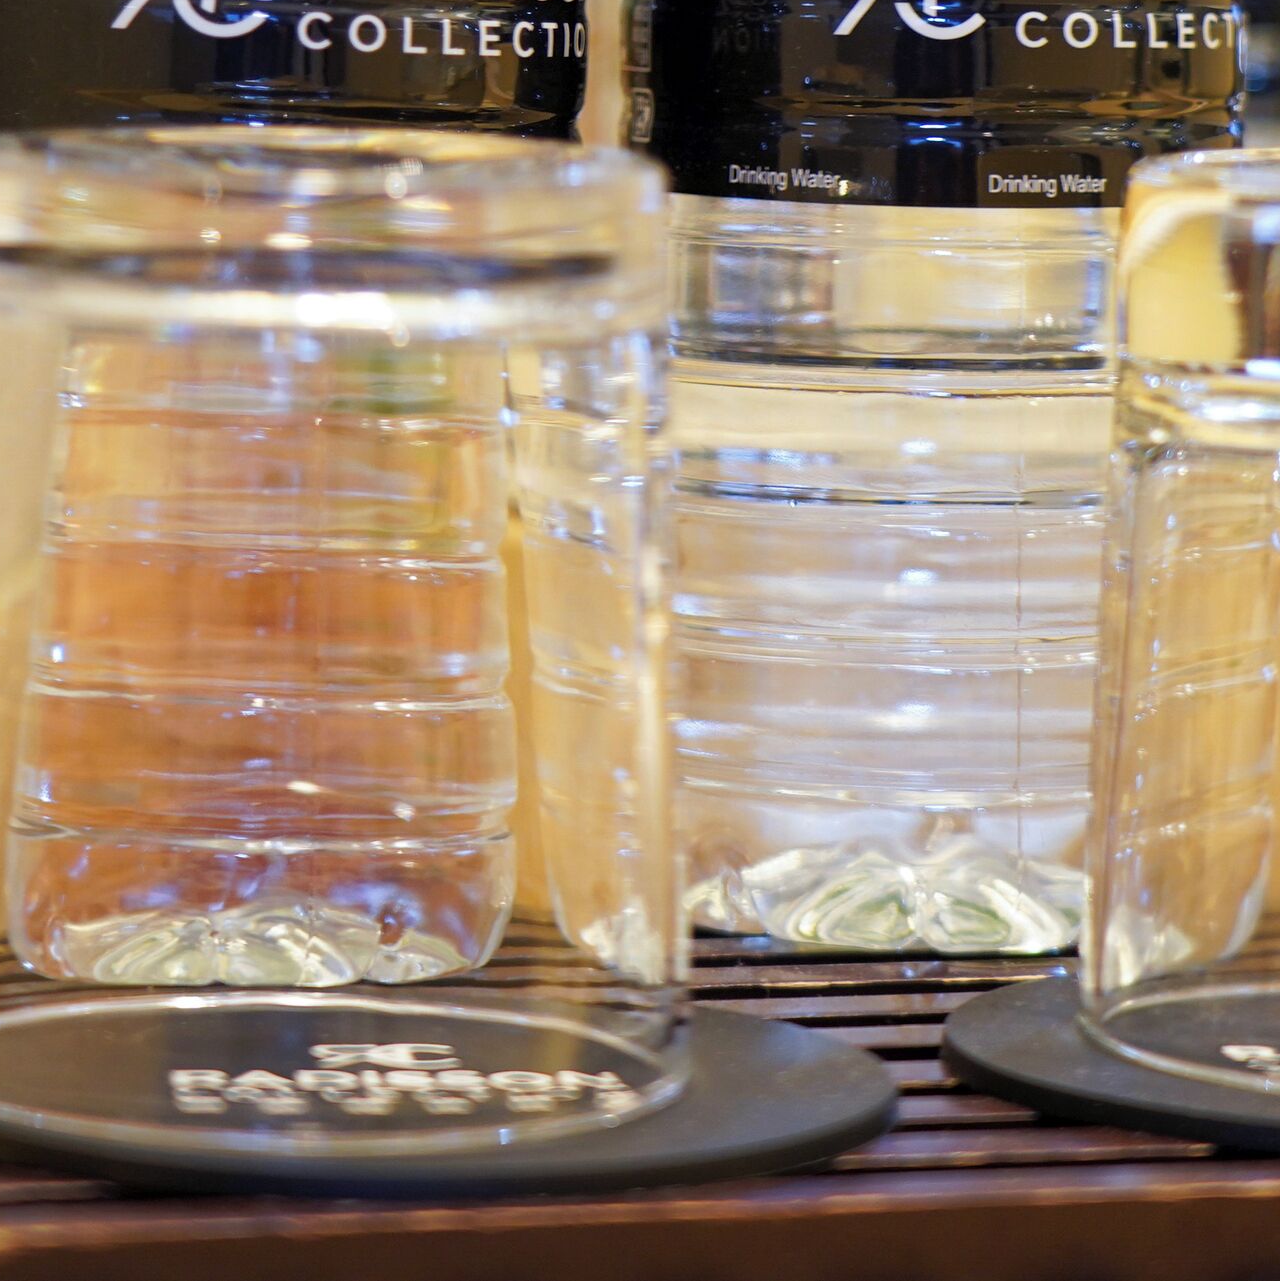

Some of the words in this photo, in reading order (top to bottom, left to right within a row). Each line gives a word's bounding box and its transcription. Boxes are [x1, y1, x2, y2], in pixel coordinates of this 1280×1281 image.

[729, 164, 787, 191] Drinking
[988, 174, 1058, 197] Drinking
[1061, 174, 1108, 194] Water
